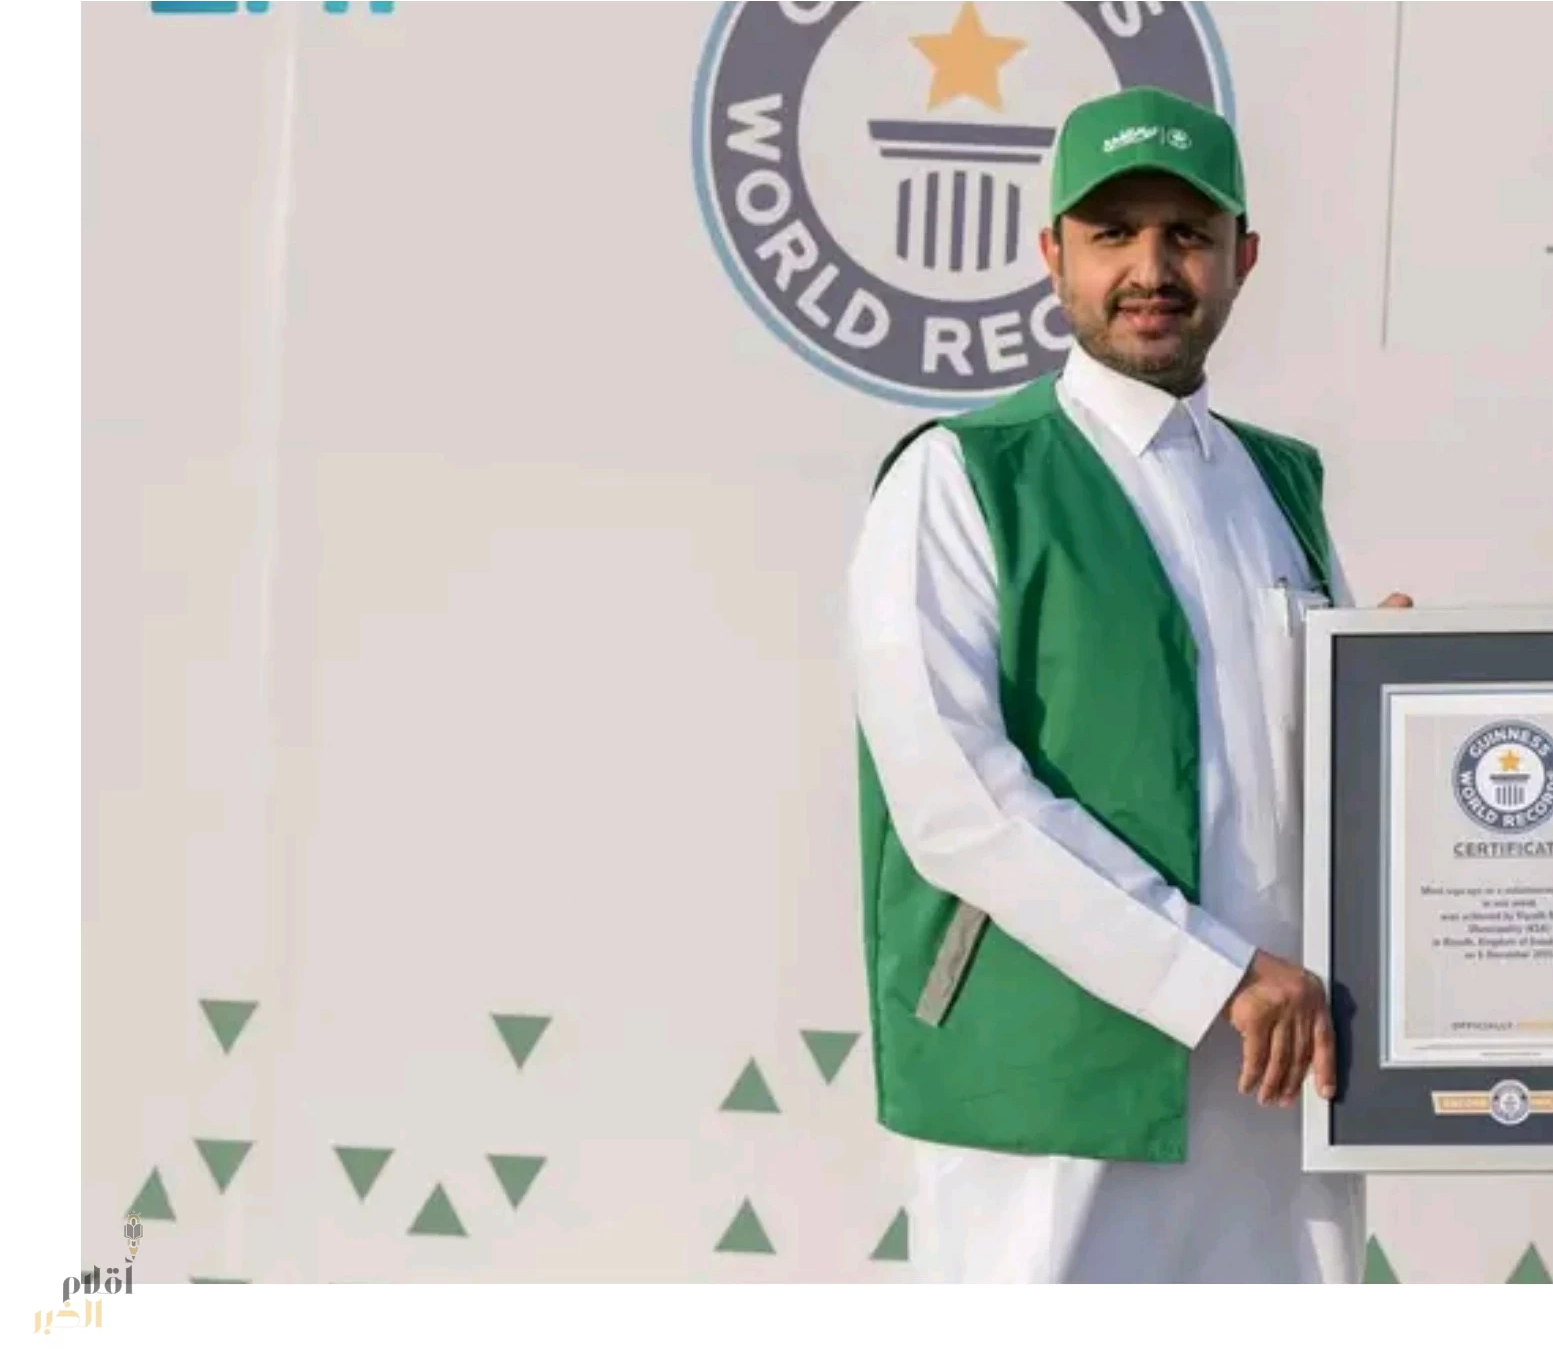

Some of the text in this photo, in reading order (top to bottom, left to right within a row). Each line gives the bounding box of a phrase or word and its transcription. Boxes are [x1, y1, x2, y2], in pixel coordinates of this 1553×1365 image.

[726, 94, 891, 351] WORLD
[1470, 728, 1550, 758] GUINNESS
[1460, 771, 1498, 824] WORLD
